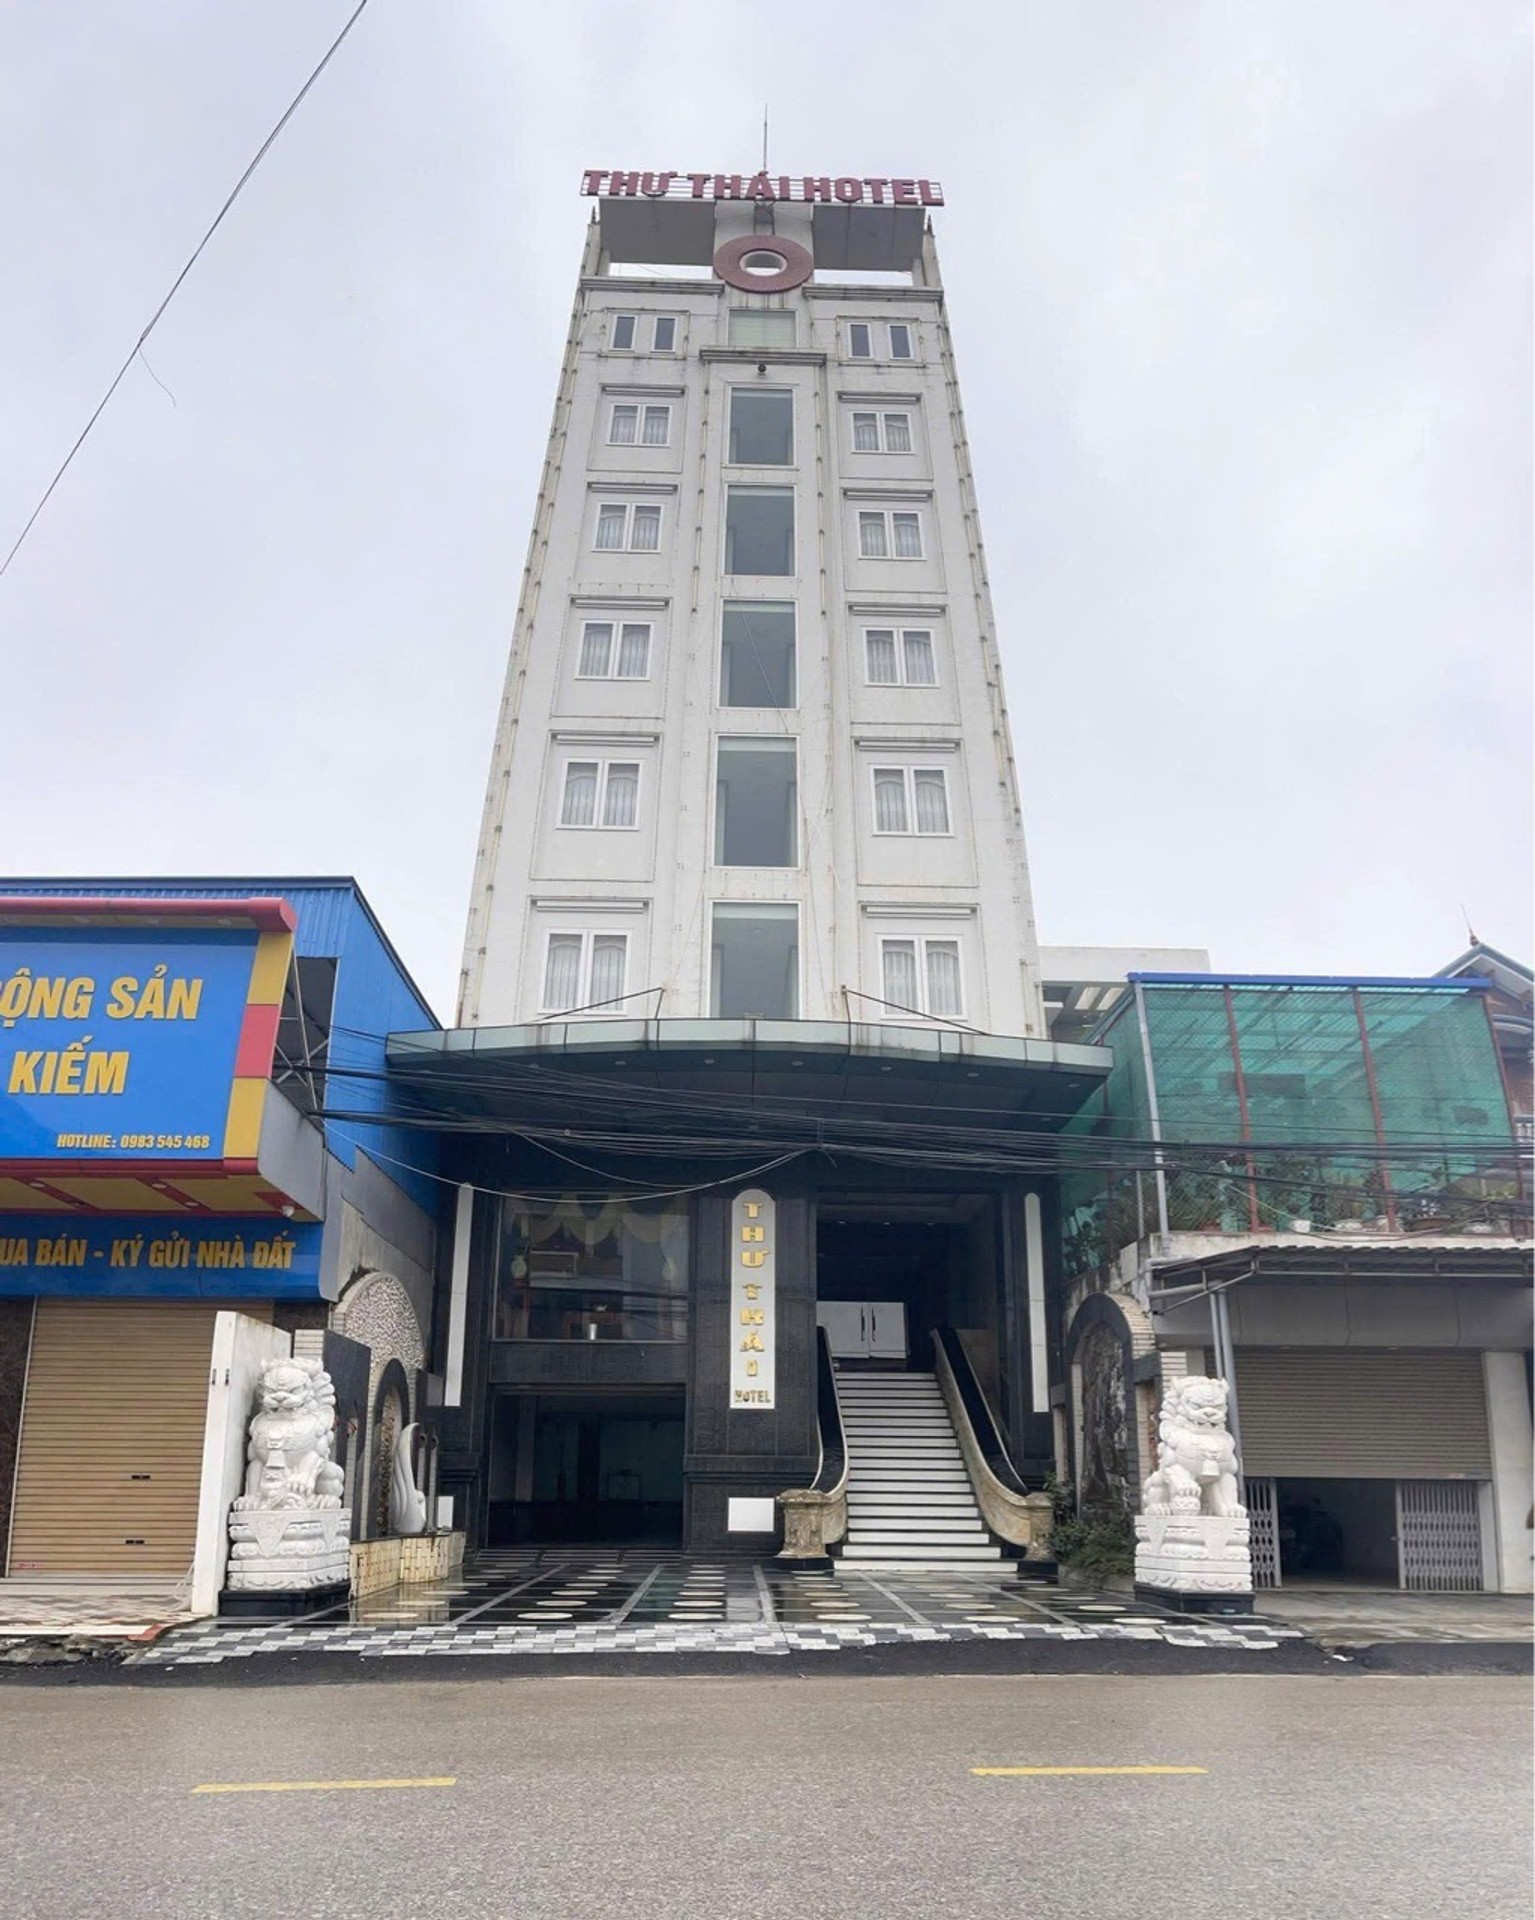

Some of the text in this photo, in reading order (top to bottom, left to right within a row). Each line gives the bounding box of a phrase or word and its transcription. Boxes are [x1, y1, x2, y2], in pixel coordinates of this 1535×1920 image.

[584, 170, 944, 206] THƯ THÁI HOTEL
[0, 964, 203, 1028] ỘNG SẢN
[8, 1035, 130, 1094] KIẾM
[56, 1134, 210, 1149] HOTLINE: 0983 545 468
[35, 1233, 87, 1266] BÁN
[110, 1233, 144, 1267] KÝ
[149, 1231, 190, 1268] GỬI
[197, 1235, 245, 1268] NHÀ
[253, 1230, 296, 1268] ĐẤT
[734, 1389, 772, 1404] HOTEL
